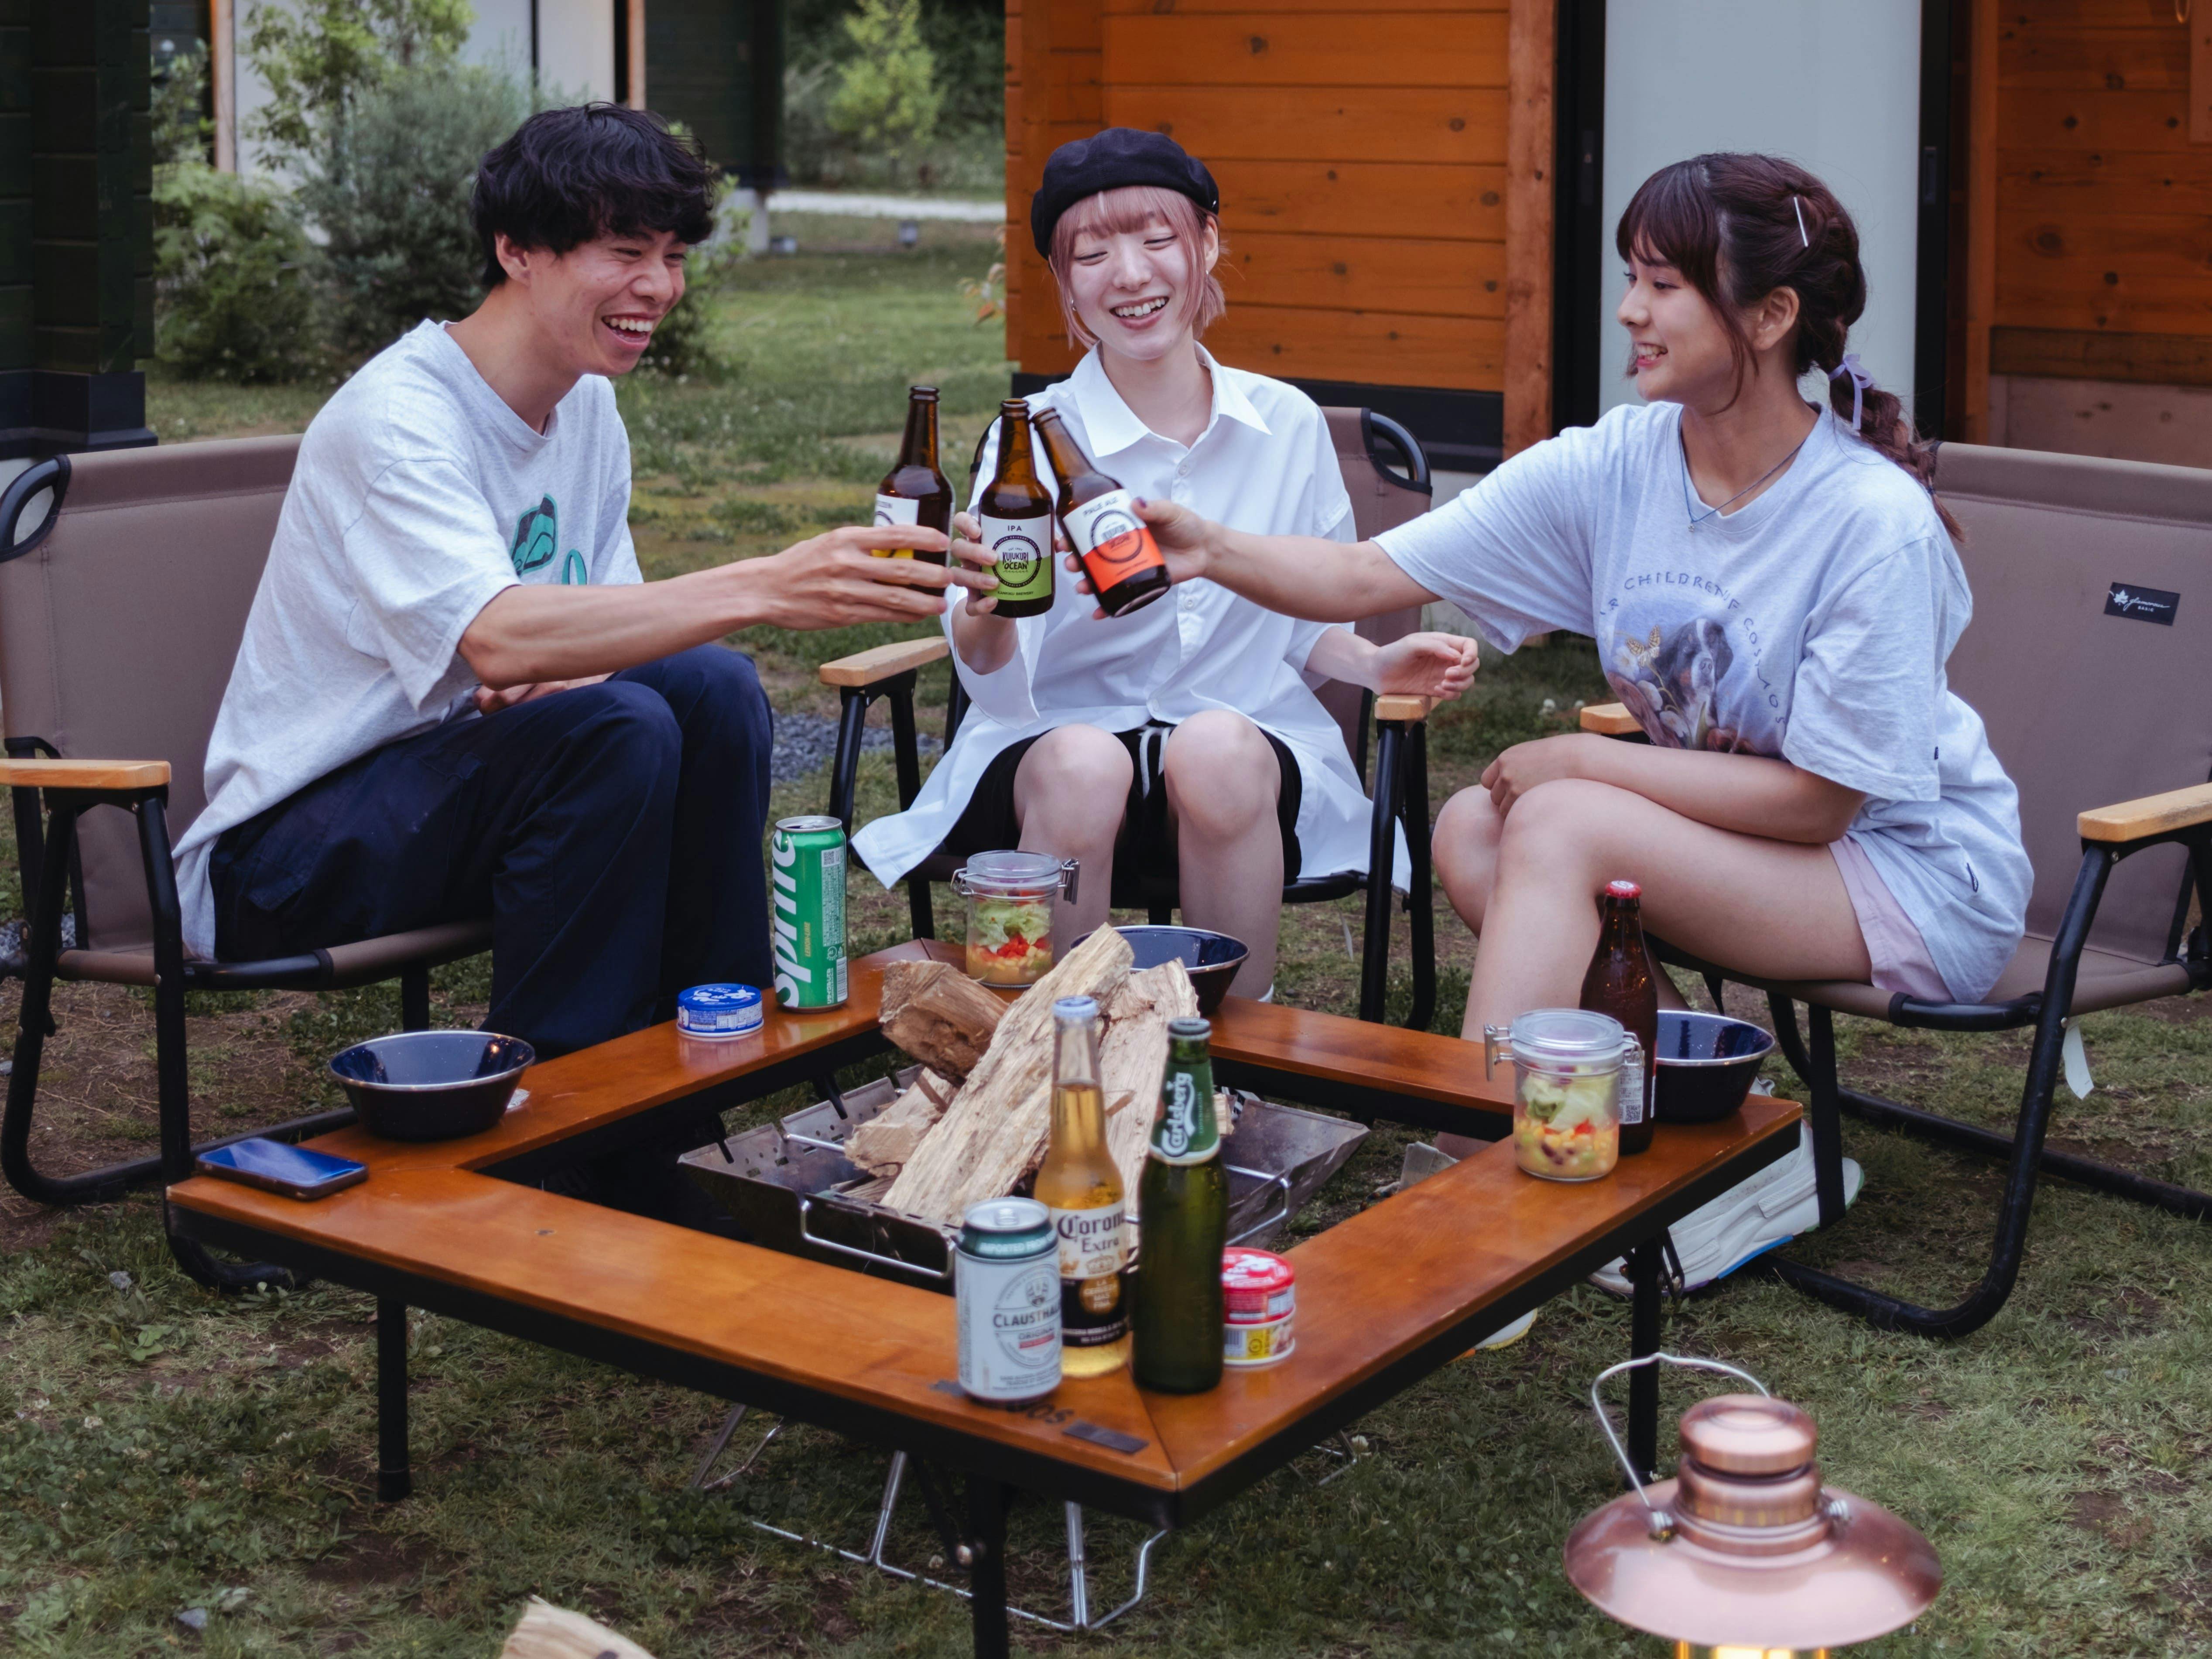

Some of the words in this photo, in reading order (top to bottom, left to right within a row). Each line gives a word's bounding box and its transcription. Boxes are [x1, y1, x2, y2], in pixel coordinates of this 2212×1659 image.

[1003, 552, 1028, 564] KUJUKURI
[1624, 571, 1724, 597] CHILDREN
[1161, 1071, 1195, 1156] Carlsberg
[1058, 1209, 1125, 1242] Coron
[979, 1242, 1025, 1255] IMPORTED
[1082, 1237, 1119, 1252] Extra
